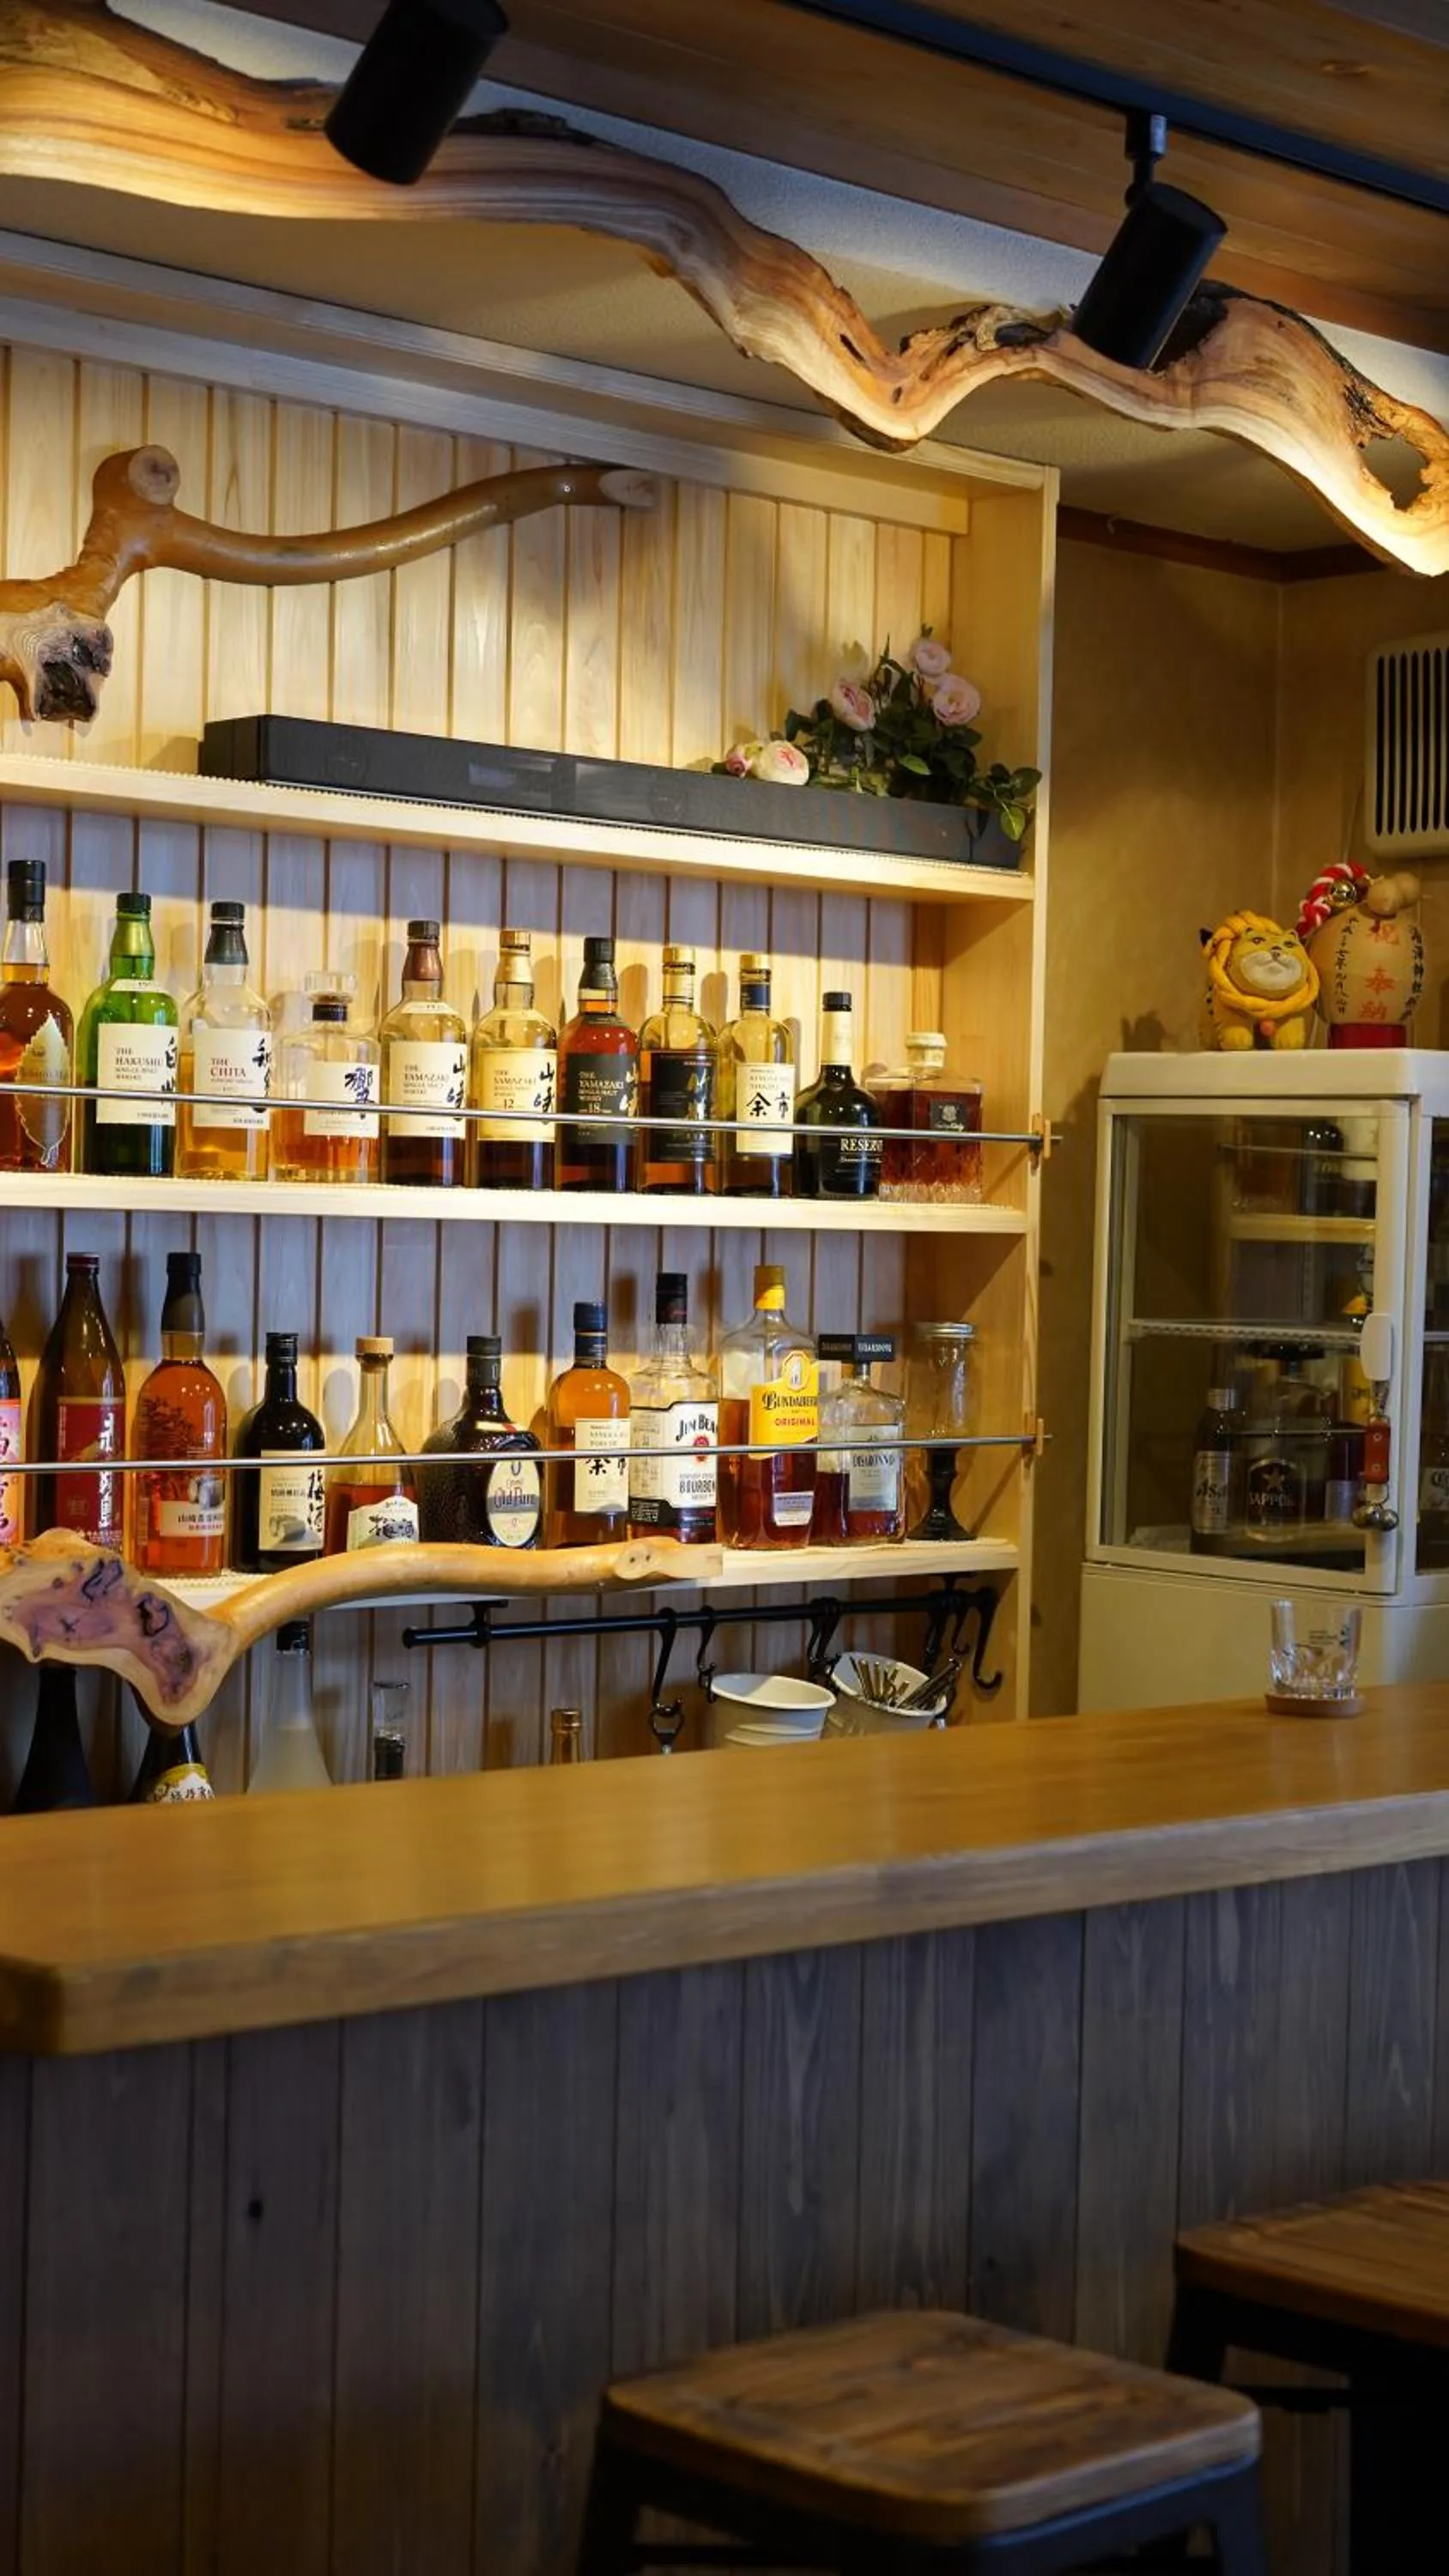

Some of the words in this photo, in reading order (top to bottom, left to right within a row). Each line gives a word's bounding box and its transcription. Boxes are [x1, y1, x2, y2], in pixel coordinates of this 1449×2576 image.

[115, 1057, 163, 1066] HAKUSHU
[210, 1057, 228, 1066] THE
[210, 1067, 246, 1078] CHITA
[579, 1079, 625, 1090] YAMAZAKI
[504, 1098, 514, 1110] 12
[588, 1102, 601, 1114] 18
[746, 1091, 791, 1120] 余市
[774, 1418, 815, 1426] ORIGINAL
